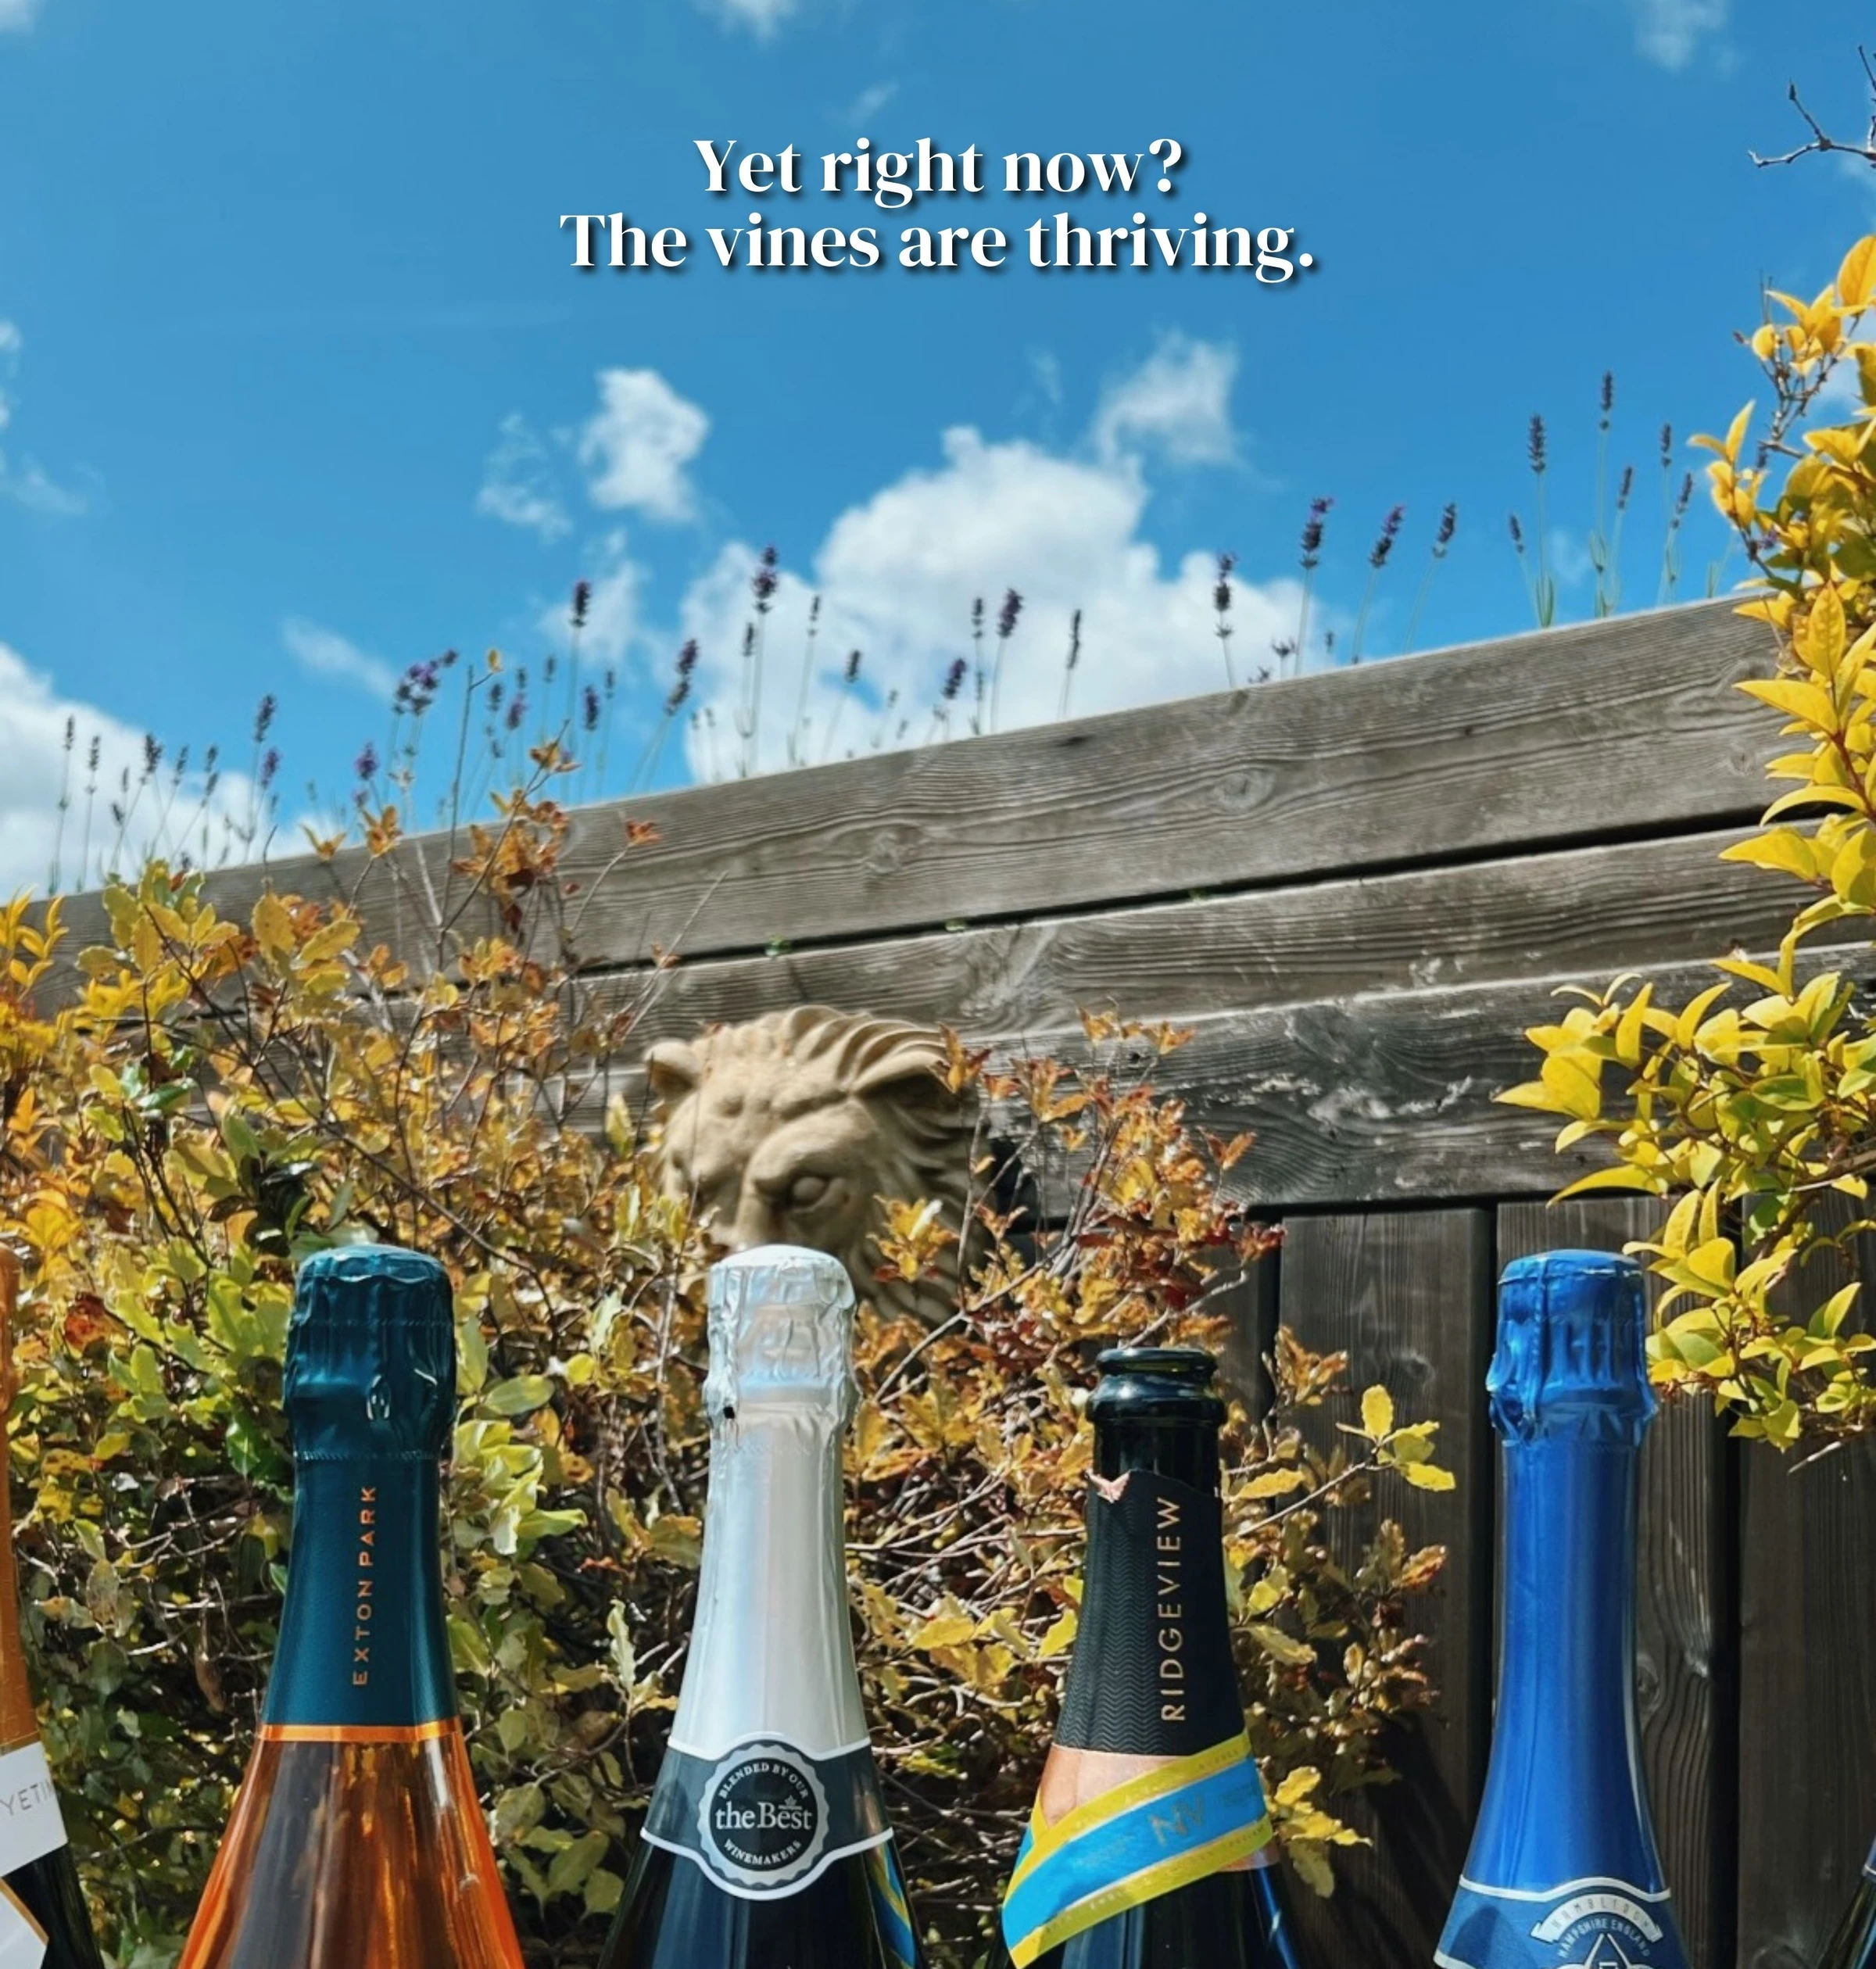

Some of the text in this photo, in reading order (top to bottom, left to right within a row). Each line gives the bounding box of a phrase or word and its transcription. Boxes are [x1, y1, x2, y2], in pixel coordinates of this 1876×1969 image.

[353, 1487, 376, 1685] EXTON PARK
[1156, 1497, 1186, 1720] RIDGEVIEW
[718, 1762, 809, 1799] BLENDED BY OUR
[714, 1799, 813, 1830] the Best
[724, 1838, 802, 1865] WINEMAKERS
